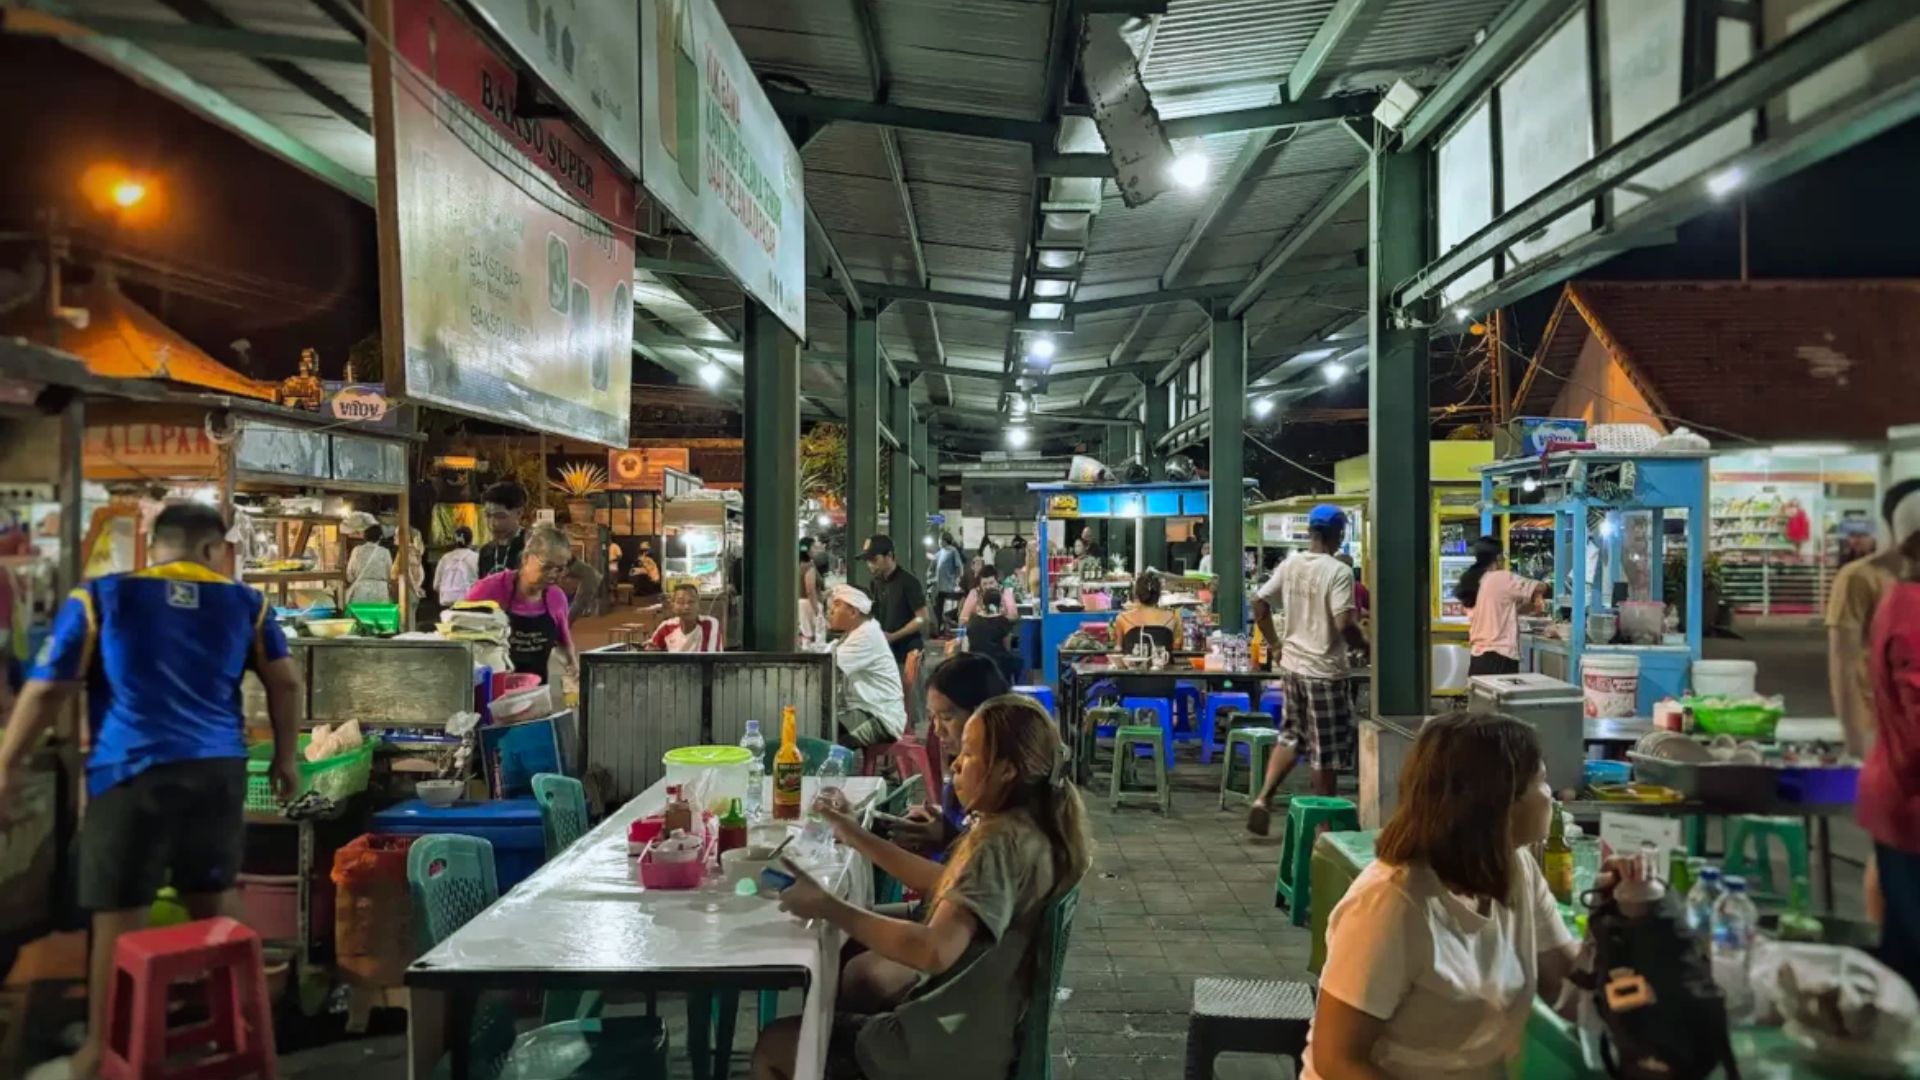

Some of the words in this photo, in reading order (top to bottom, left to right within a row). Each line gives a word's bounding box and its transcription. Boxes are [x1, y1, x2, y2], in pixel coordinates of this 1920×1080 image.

[482, 70, 544, 154] BAKSO
[547, 135, 594, 199] SUPER
[469, 246, 500, 281] BAKSO
[470, 303, 503, 337] BAKSO
